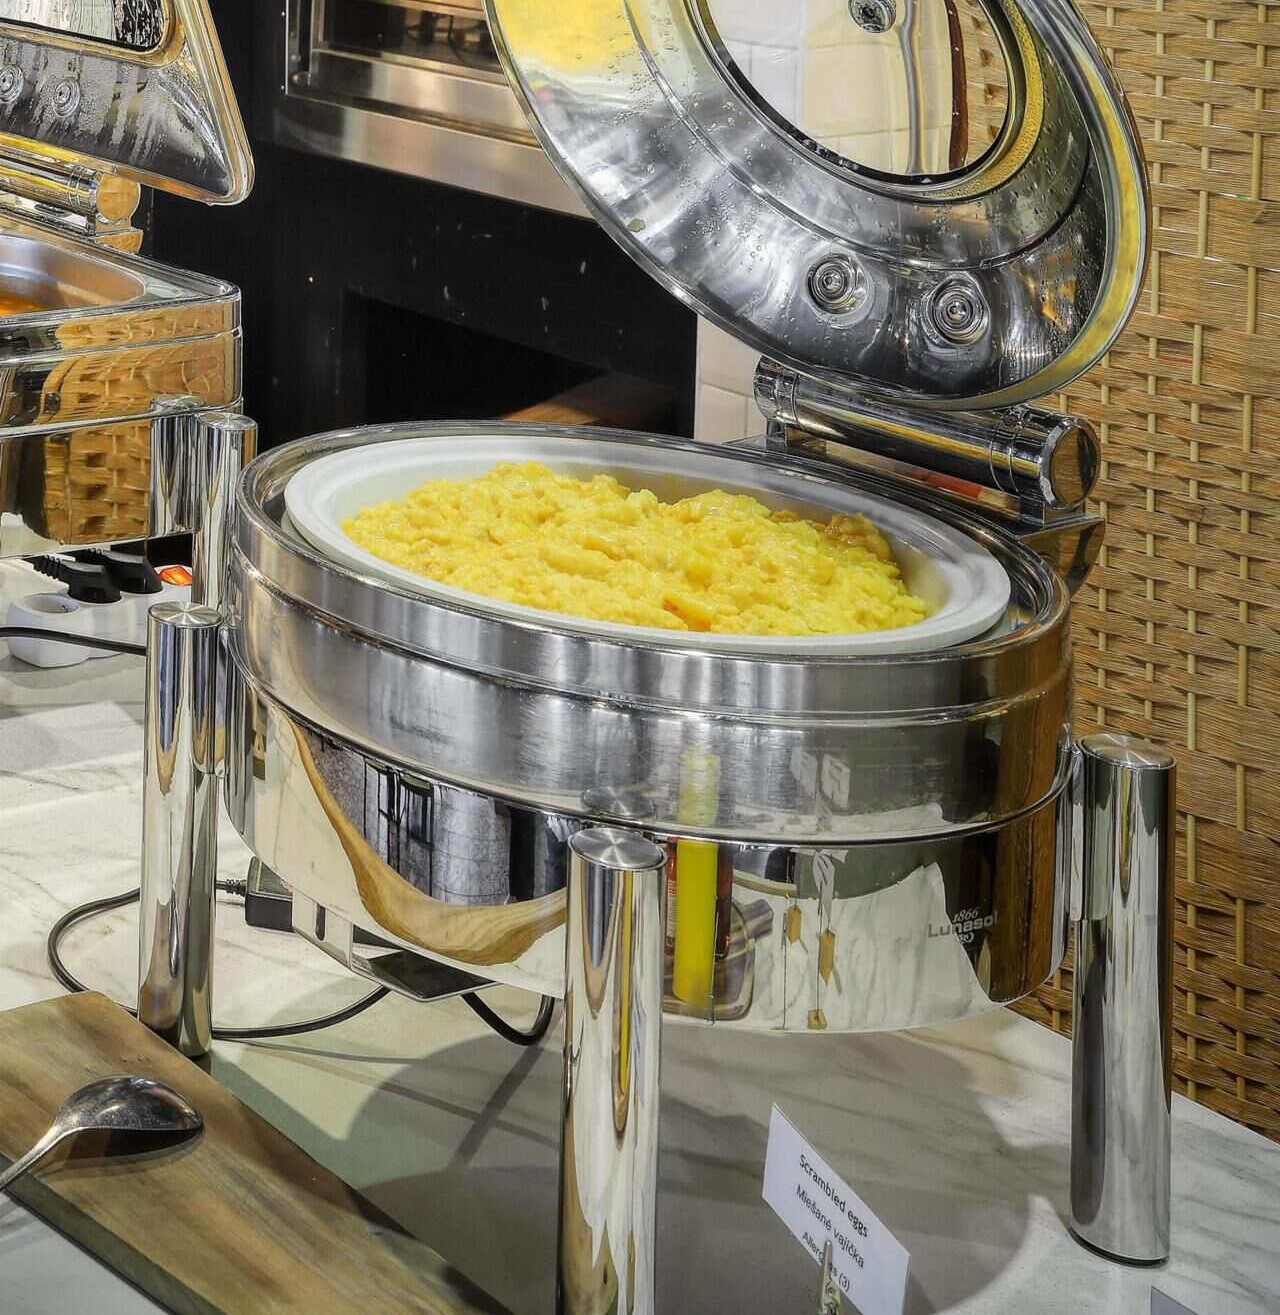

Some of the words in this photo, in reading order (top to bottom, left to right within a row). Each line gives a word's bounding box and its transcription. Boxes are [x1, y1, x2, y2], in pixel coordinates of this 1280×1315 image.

[928, 909, 998, 938] Lunasol
[952, 906, 979, 923] 1866
[799, 1154, 846, 1214] Scrambled
[847, 1210, 868, 1238] eggs
[796, 1184, 832, 1231] Miešané
[834, 1227, 864, 1269] vajíčka
